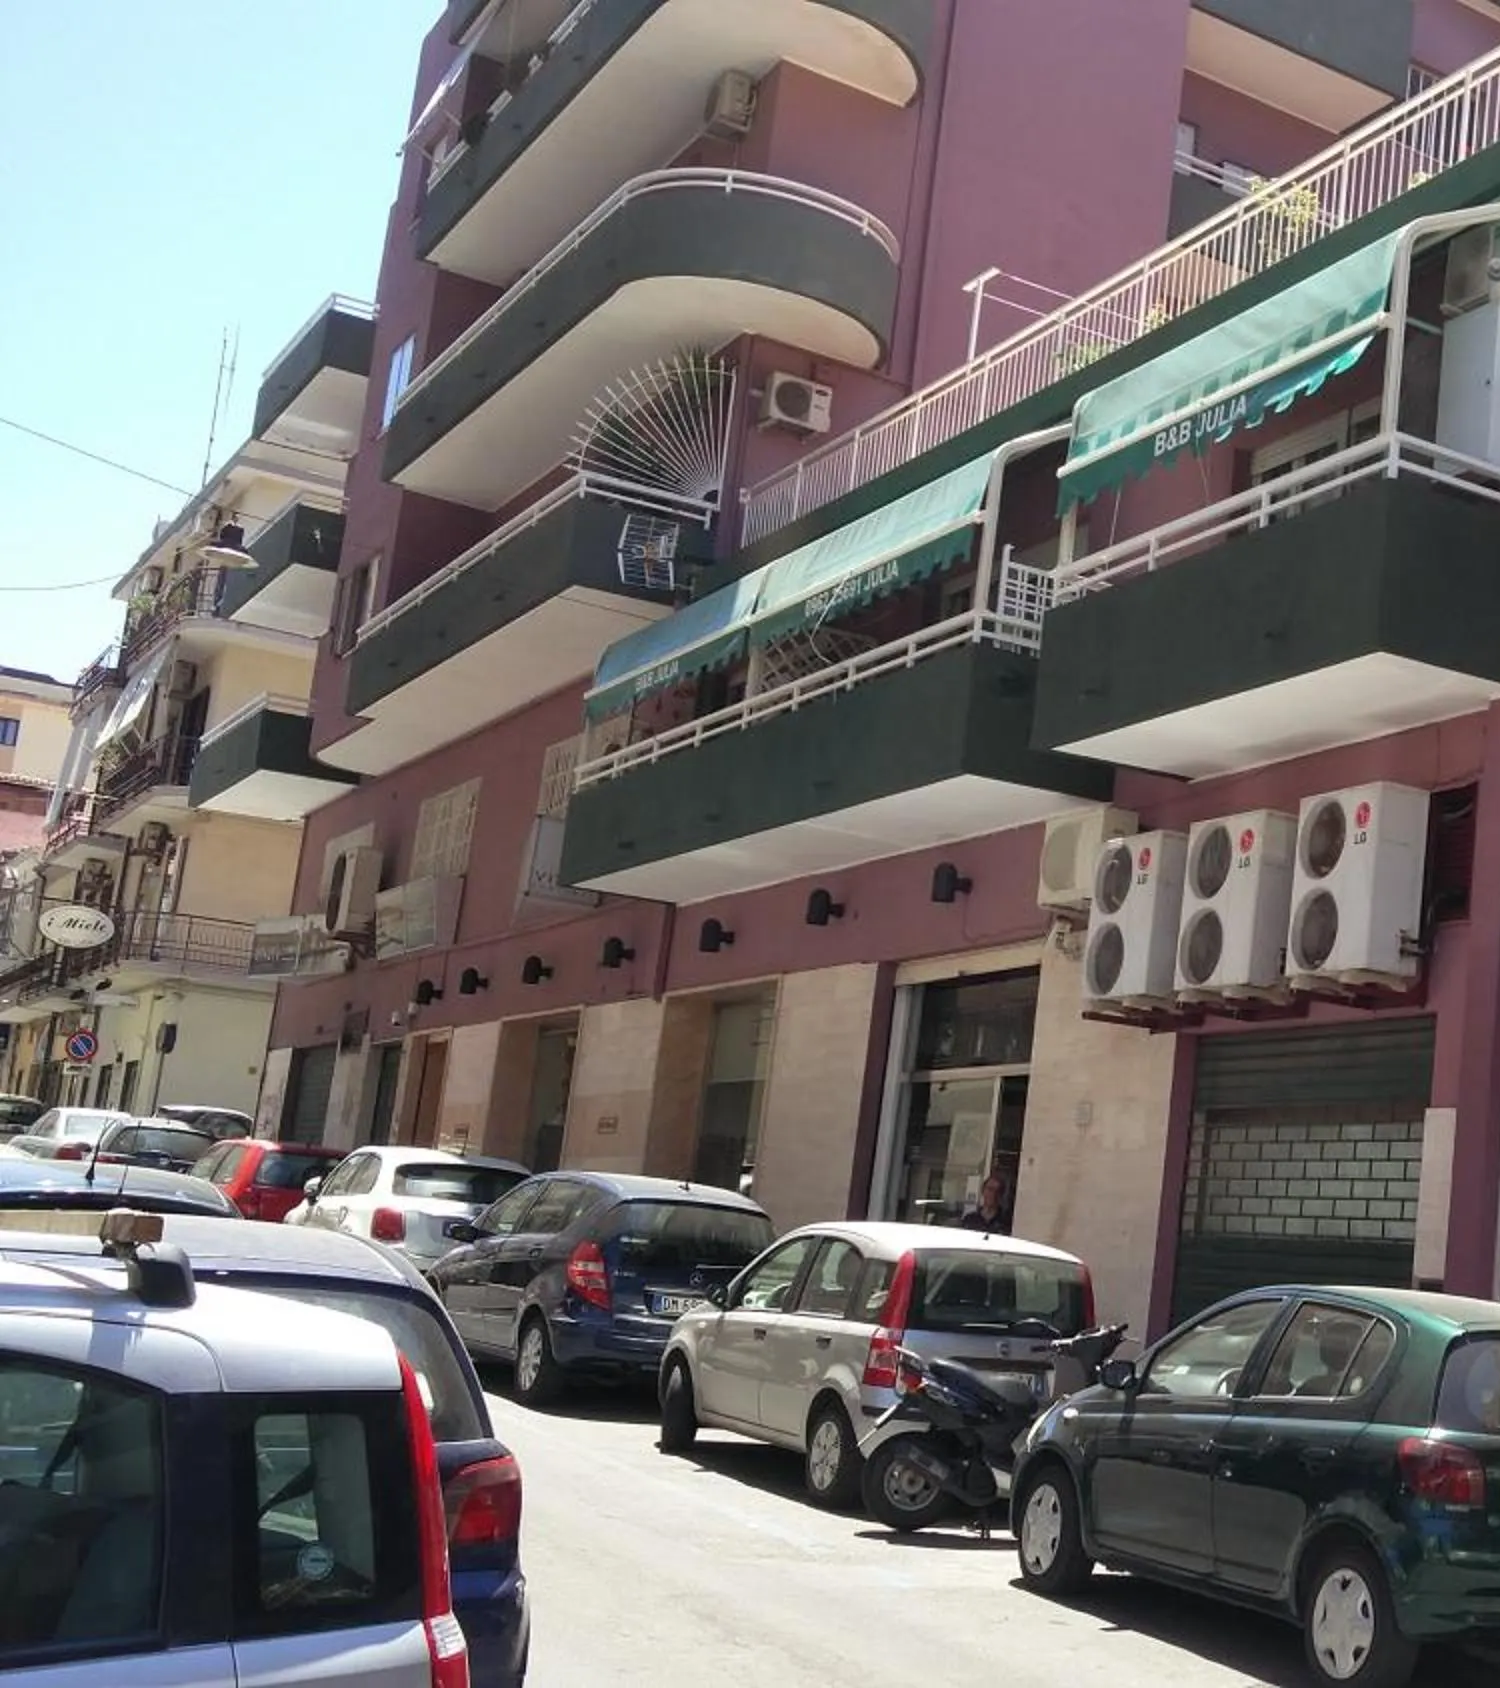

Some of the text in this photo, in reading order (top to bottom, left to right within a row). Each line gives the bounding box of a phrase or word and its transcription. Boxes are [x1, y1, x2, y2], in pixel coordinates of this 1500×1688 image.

[1153, 394, 1247, 457] B&B JULIA
[862, 559, 899, 592] JULIA
[1354, 831, 1367, 845] LG
[1238, 856, 1250, 869] LG
